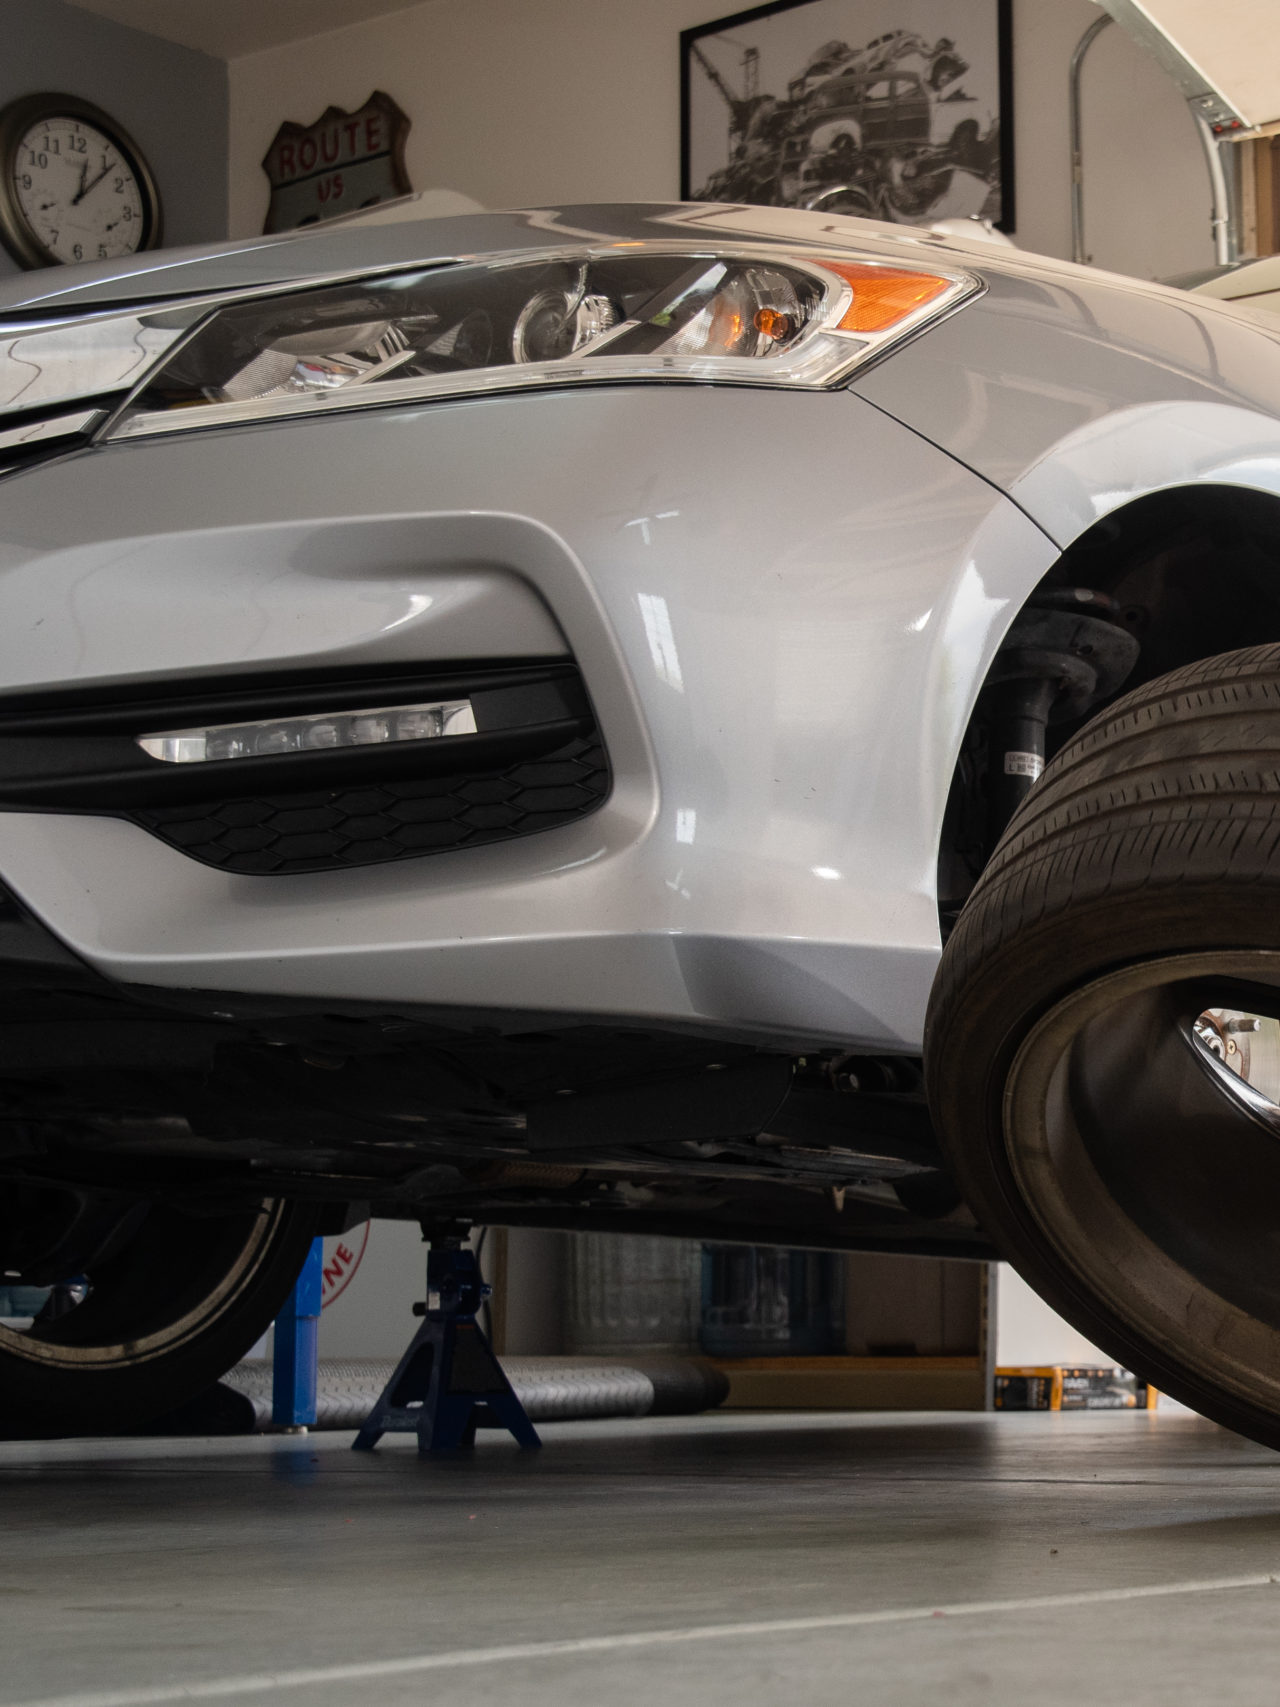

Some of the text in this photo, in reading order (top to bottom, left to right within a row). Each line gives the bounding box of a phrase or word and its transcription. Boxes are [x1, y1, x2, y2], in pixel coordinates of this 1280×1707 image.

[43, 135, 61, 155] 11
[68, 134, 87, 154] 12
[279, 117, 380, 178] ROUTE
[29, 150, 48, 169] 10
[22, 174, 32, 190] 9
[114, 178, 124, 194] 2
[318, 174, 343, 203] US
[122, 206, 132, 222] 3
[50, 229, 59, 245] 7
[73, 244, 82, 260] 6
[98, 244, 107, 259] 5
[322, 1242, 354, 1296] NE
